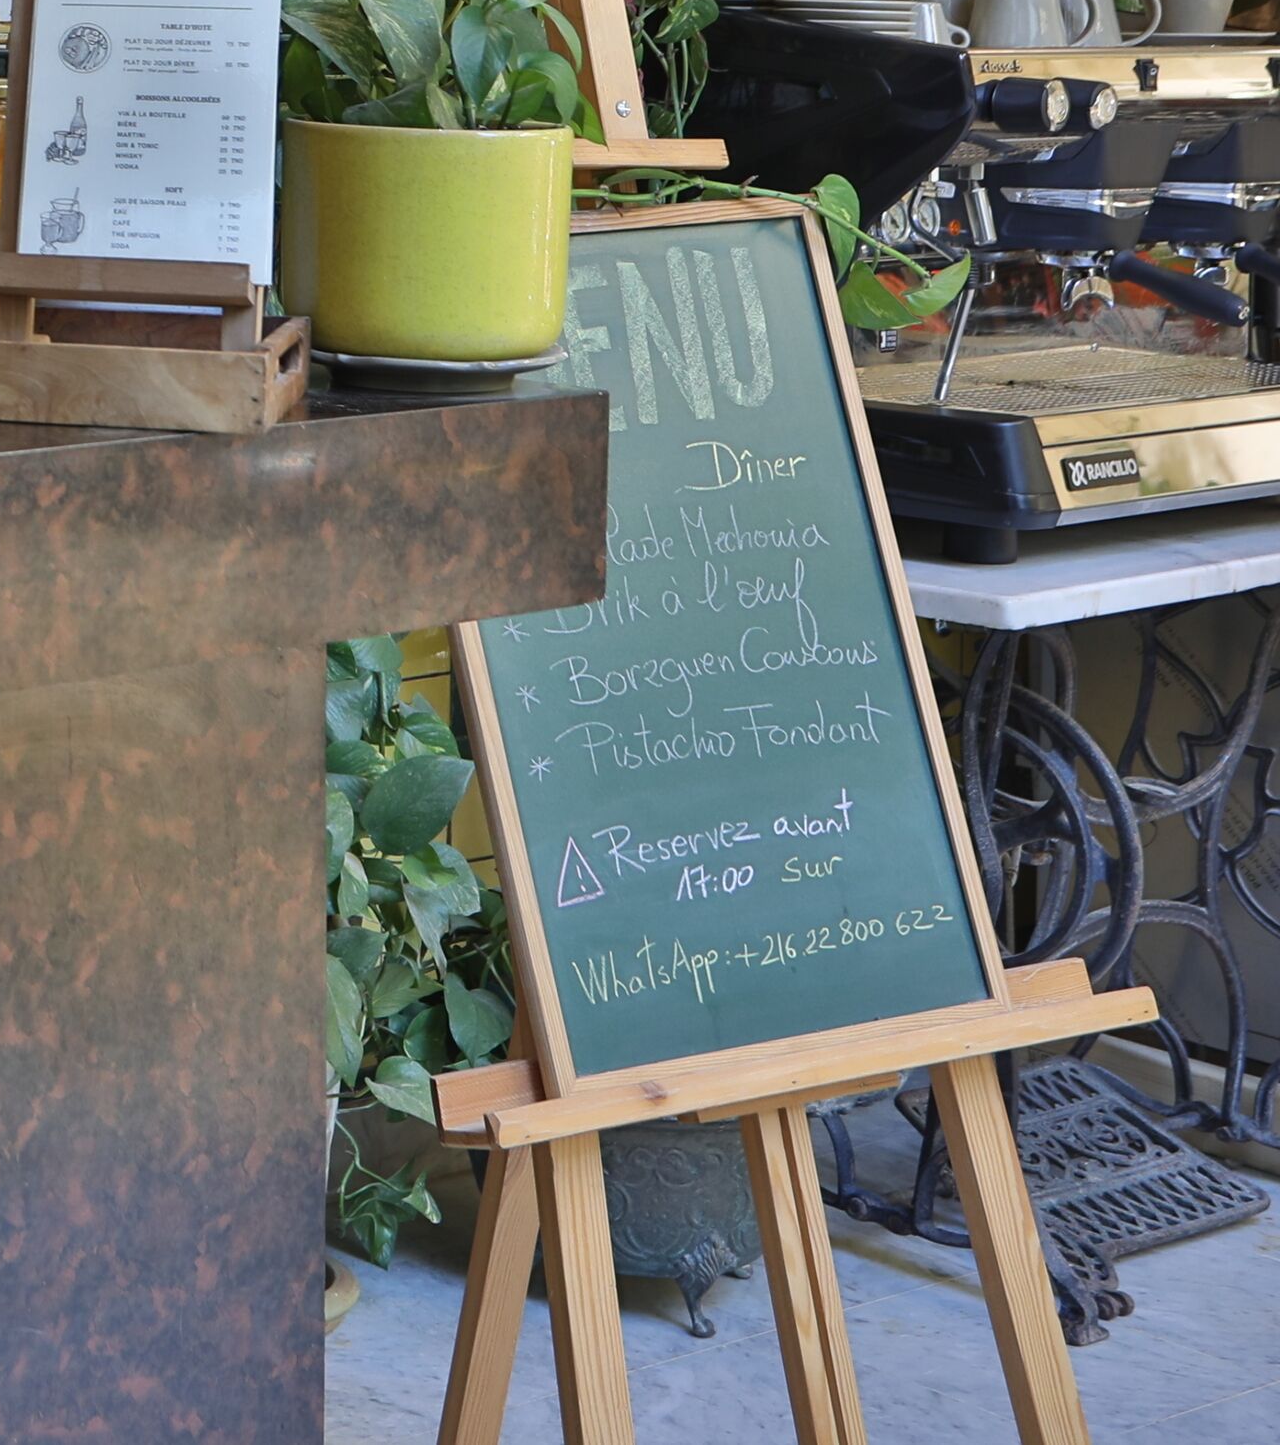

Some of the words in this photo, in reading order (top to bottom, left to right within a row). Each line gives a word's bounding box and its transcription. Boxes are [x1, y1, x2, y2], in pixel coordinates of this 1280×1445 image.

[160, 23, 183, 31] TABLE
[1086, 458, 1137, 480] RANCILIO
[723, 690, 891, 756] Fondant
[773, 788, 854, 838] avant
[676, 864, 754, 902] 17:00
